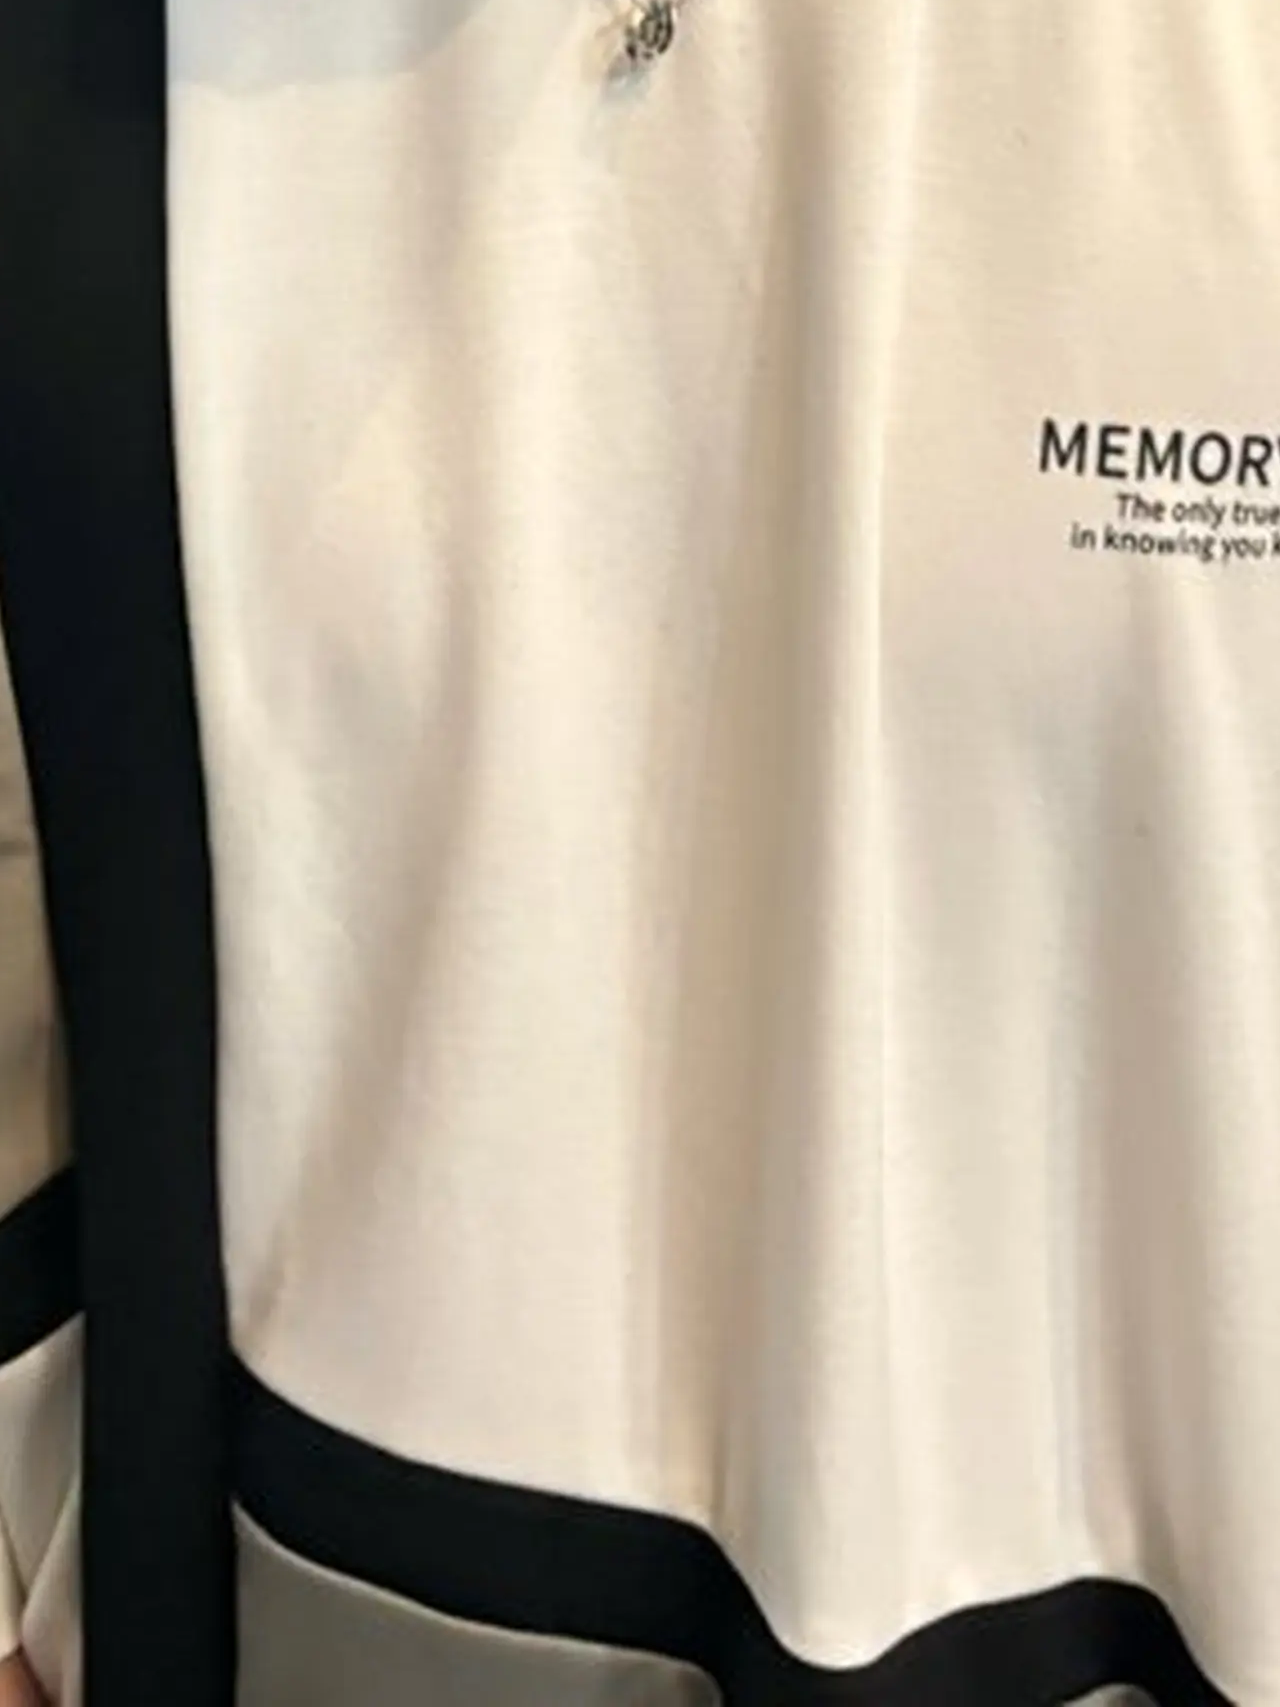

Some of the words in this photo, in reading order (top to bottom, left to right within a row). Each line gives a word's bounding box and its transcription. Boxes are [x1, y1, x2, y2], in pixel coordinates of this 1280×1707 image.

[1117, 493, 1166, 523] The
[1171, 496, 1226, 529] only
[1070, 523, 1096, 551] in
[1103, 525, 1215, 564] knowing
[1222, 536, 1266, 566] you
